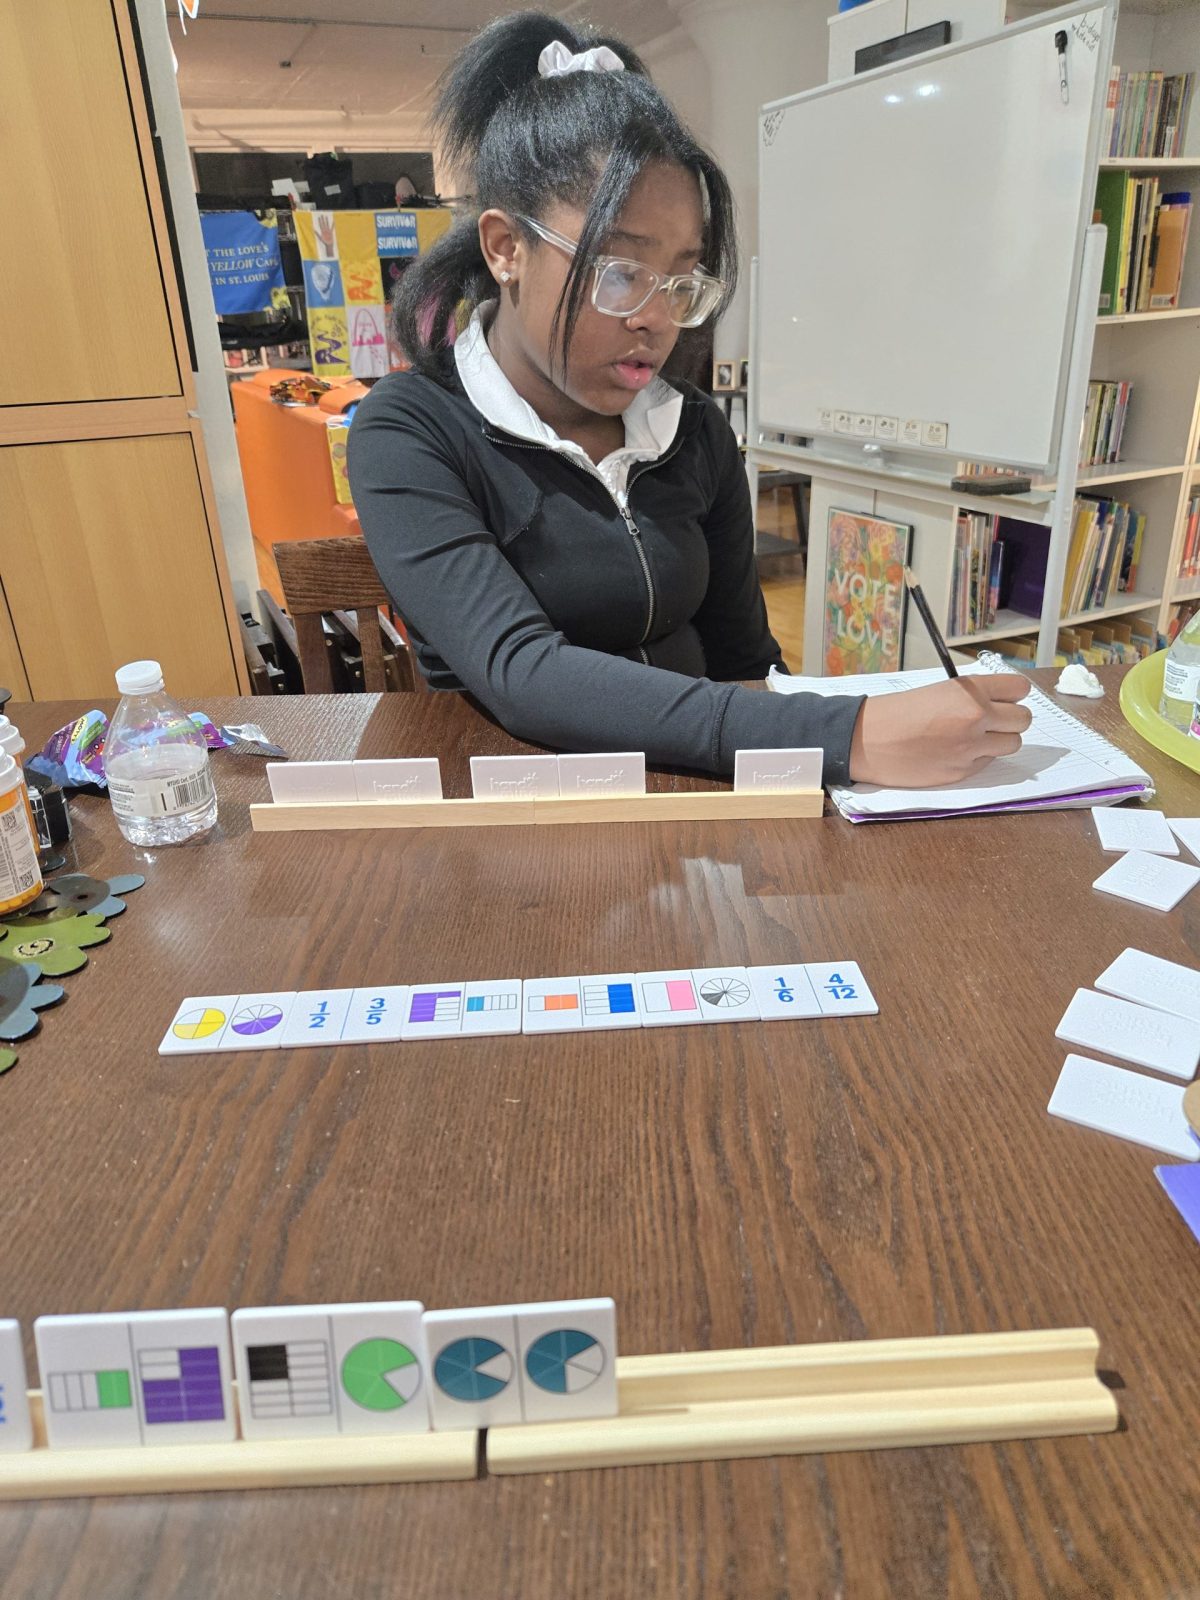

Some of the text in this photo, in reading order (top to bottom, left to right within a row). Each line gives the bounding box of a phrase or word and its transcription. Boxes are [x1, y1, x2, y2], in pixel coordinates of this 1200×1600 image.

[213, 248, 235, 257] THE
[210, 258, 255, 272] YELLOW
[215, 276, 226, 286] IN
[243, 272, 270, 284] LOUIS
[834, 567, 897, 614] VOTE
[837, 609, 894, 657] LOVE
[774, 977, 786, 988] 1
[828, 973, 844, 984] 4
[778, 990, 794, 1002] 6
[827, 987, 858, 1000] 12
[317, 1001, 328, 1012] 1
[369, 997, 385, 1009] 3
[308, 1016, 326, 1028] 2
[365, 1013, 382, 1025] 5
